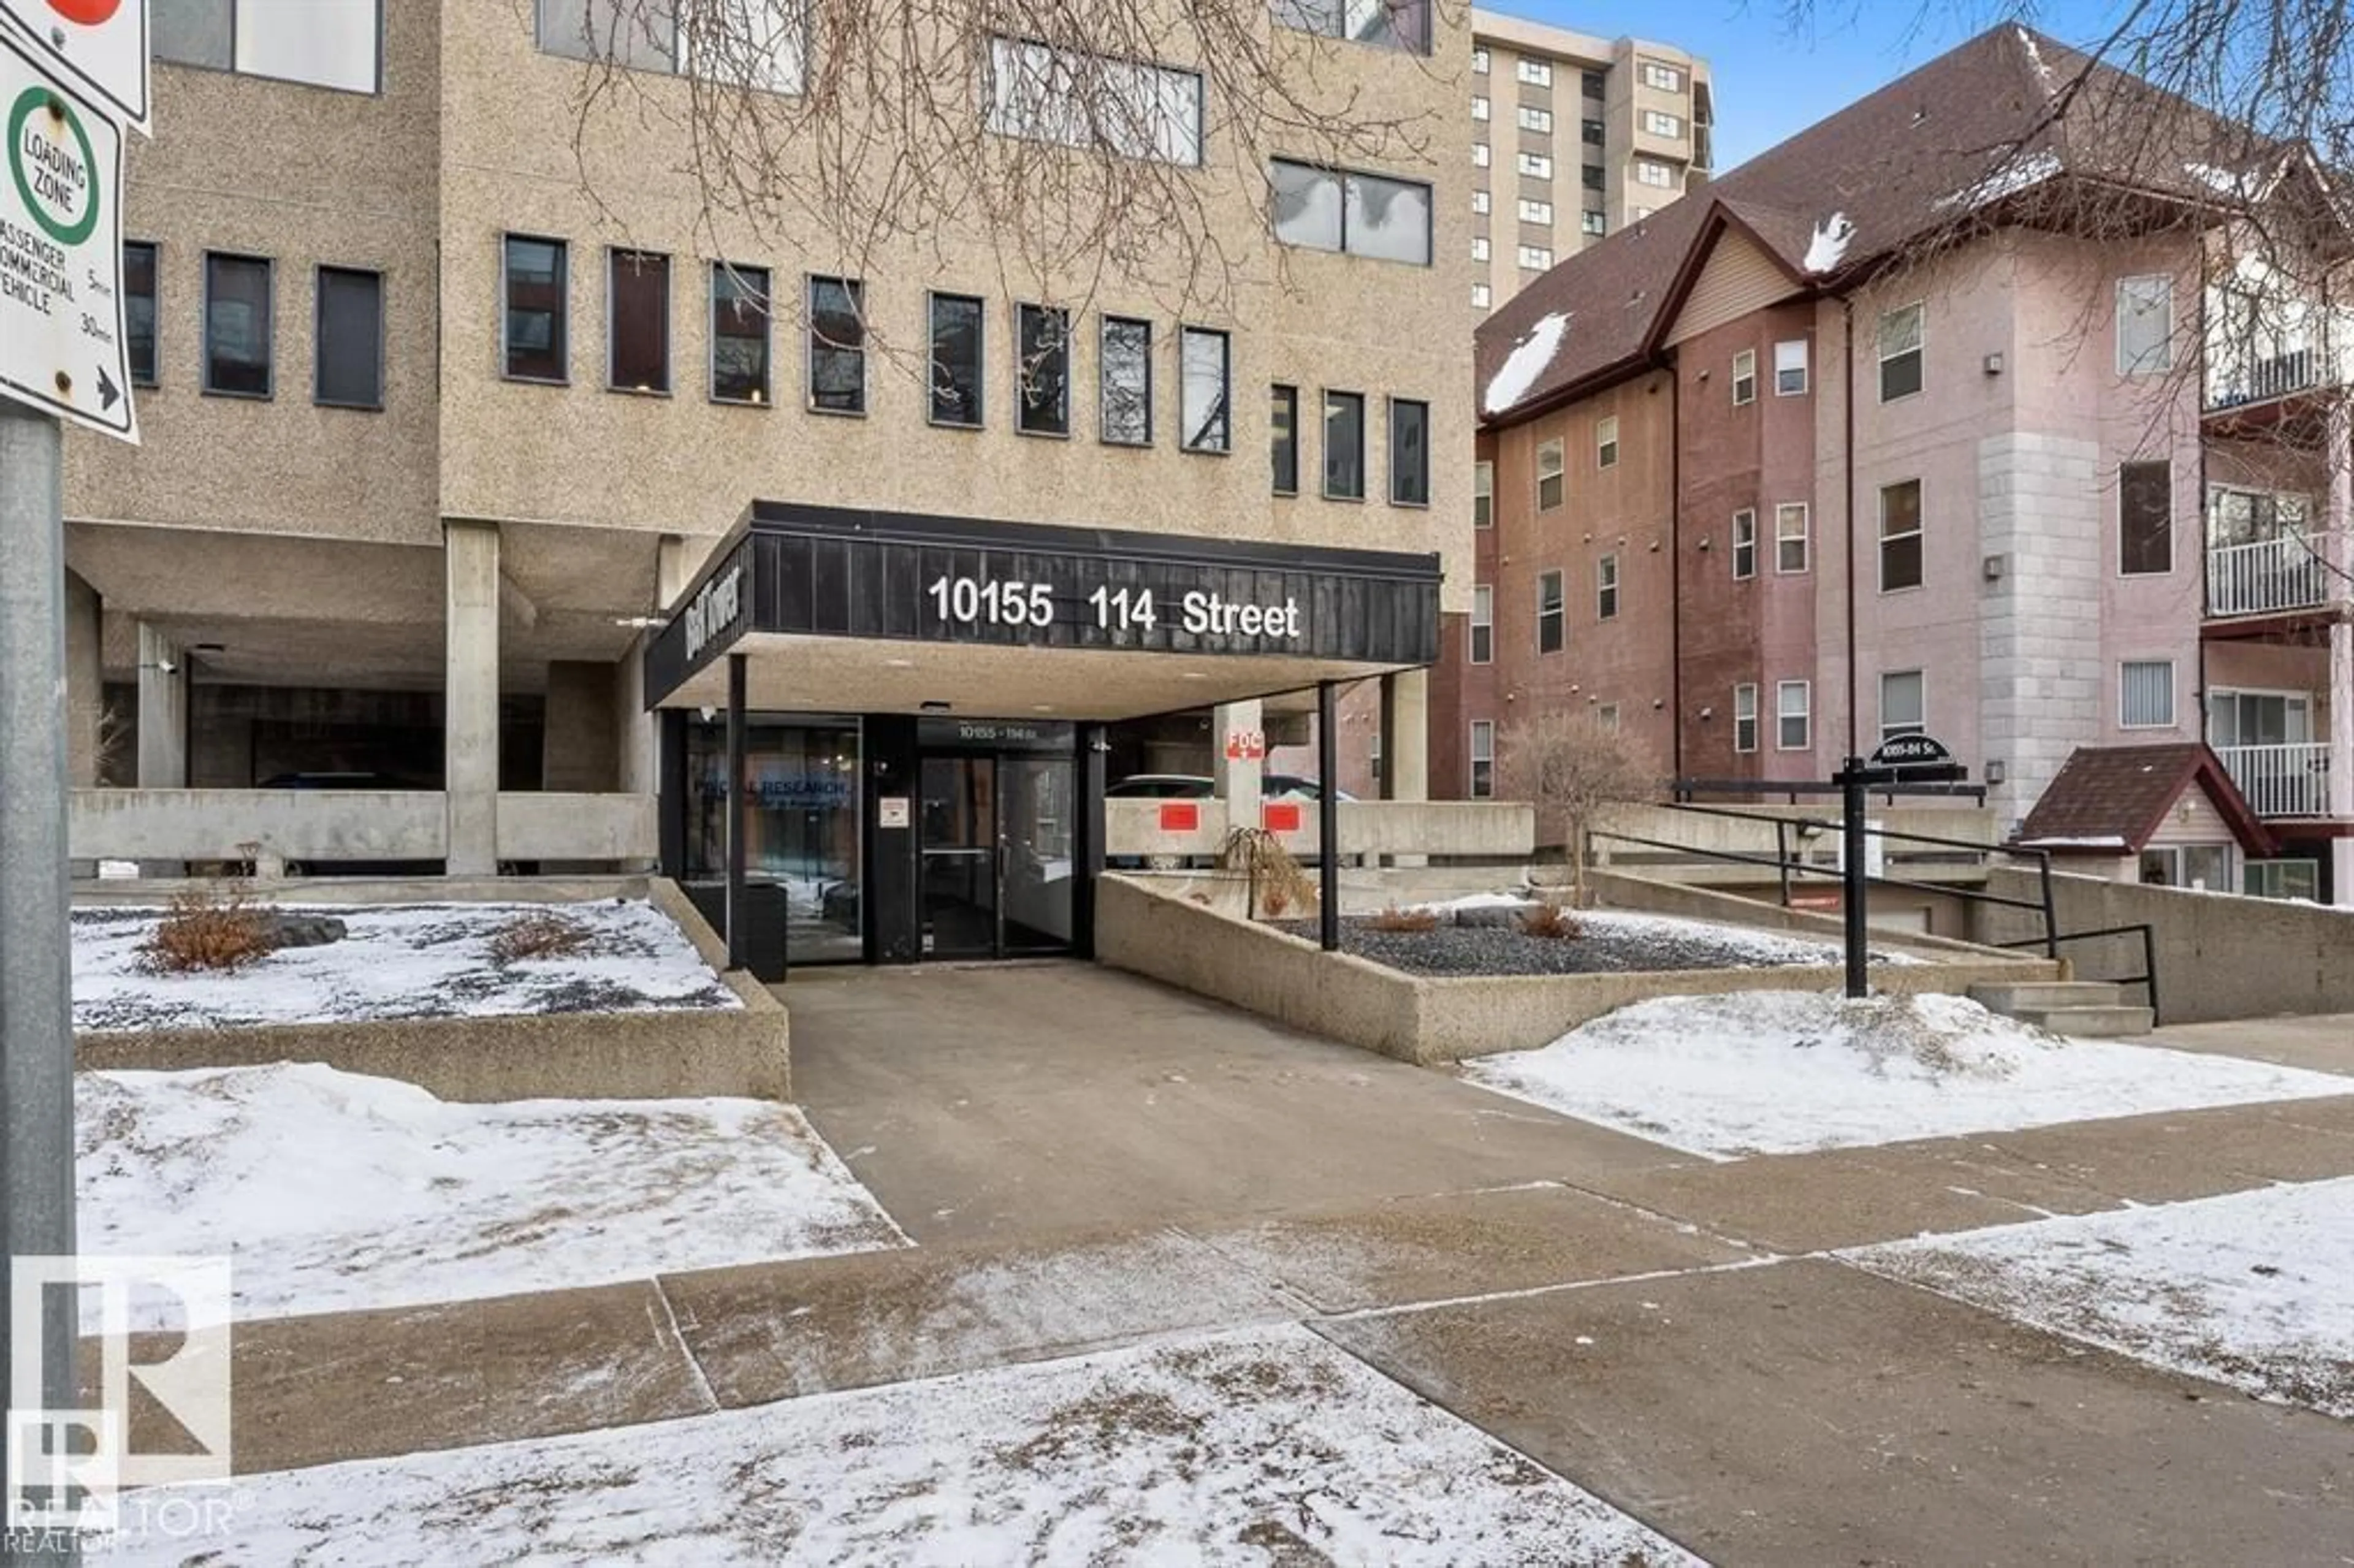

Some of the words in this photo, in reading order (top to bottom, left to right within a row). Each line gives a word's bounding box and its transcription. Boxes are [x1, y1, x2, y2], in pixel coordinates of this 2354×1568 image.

[25, 127, 85, 189] LOADING
[34, 165, 73, 213] ZONE
[0, 219, 66, 272] ASSENGER
[0, 245, 75, 303] OMMERCIAL
[0, 271, 51, 315] EHICLE
[928, 576, 1054, 626] 10155
[1089, 585, 1157, 632] 114
[1182, 590, 1301, 638] Street
[1230, 732, 1262, 748] FDC
